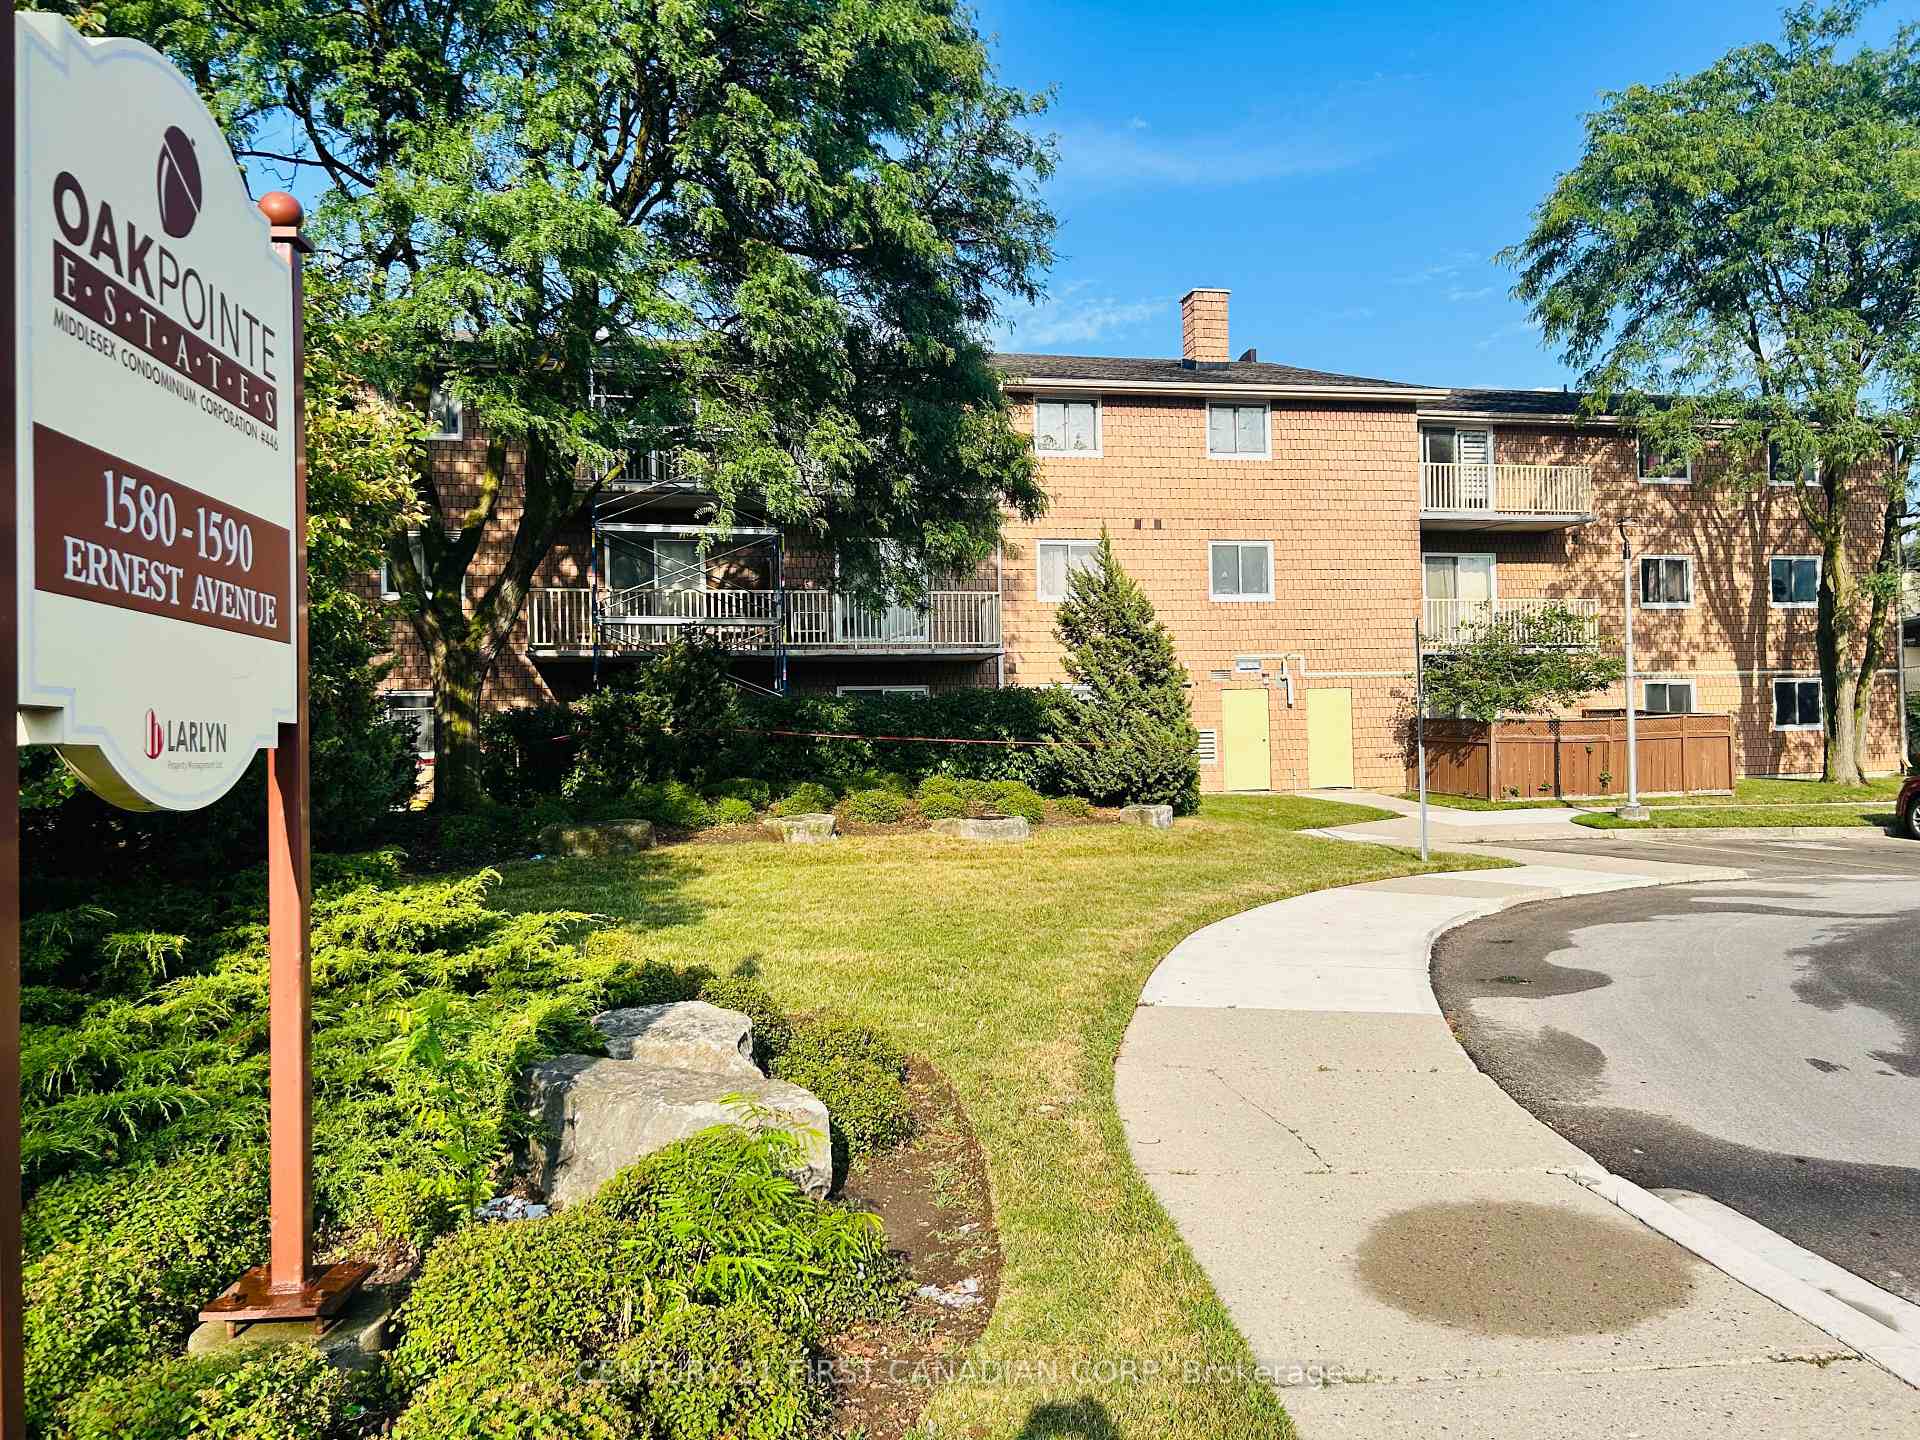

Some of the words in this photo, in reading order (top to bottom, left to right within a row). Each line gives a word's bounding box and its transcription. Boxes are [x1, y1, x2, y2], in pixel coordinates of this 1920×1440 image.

[53, 171, 276, 381] OAKPOINTE
[53, 308, 117, 361] MIDDLESEX
[121, 348, 197, 407] CONDOMINIUM
[201, 394, 257, 439] CORPORATION
[64, 535, 183, 606] ERNEST
[192, 573, 278, 629] AVENUE
[168, 719, 227, 753] LARLYN
